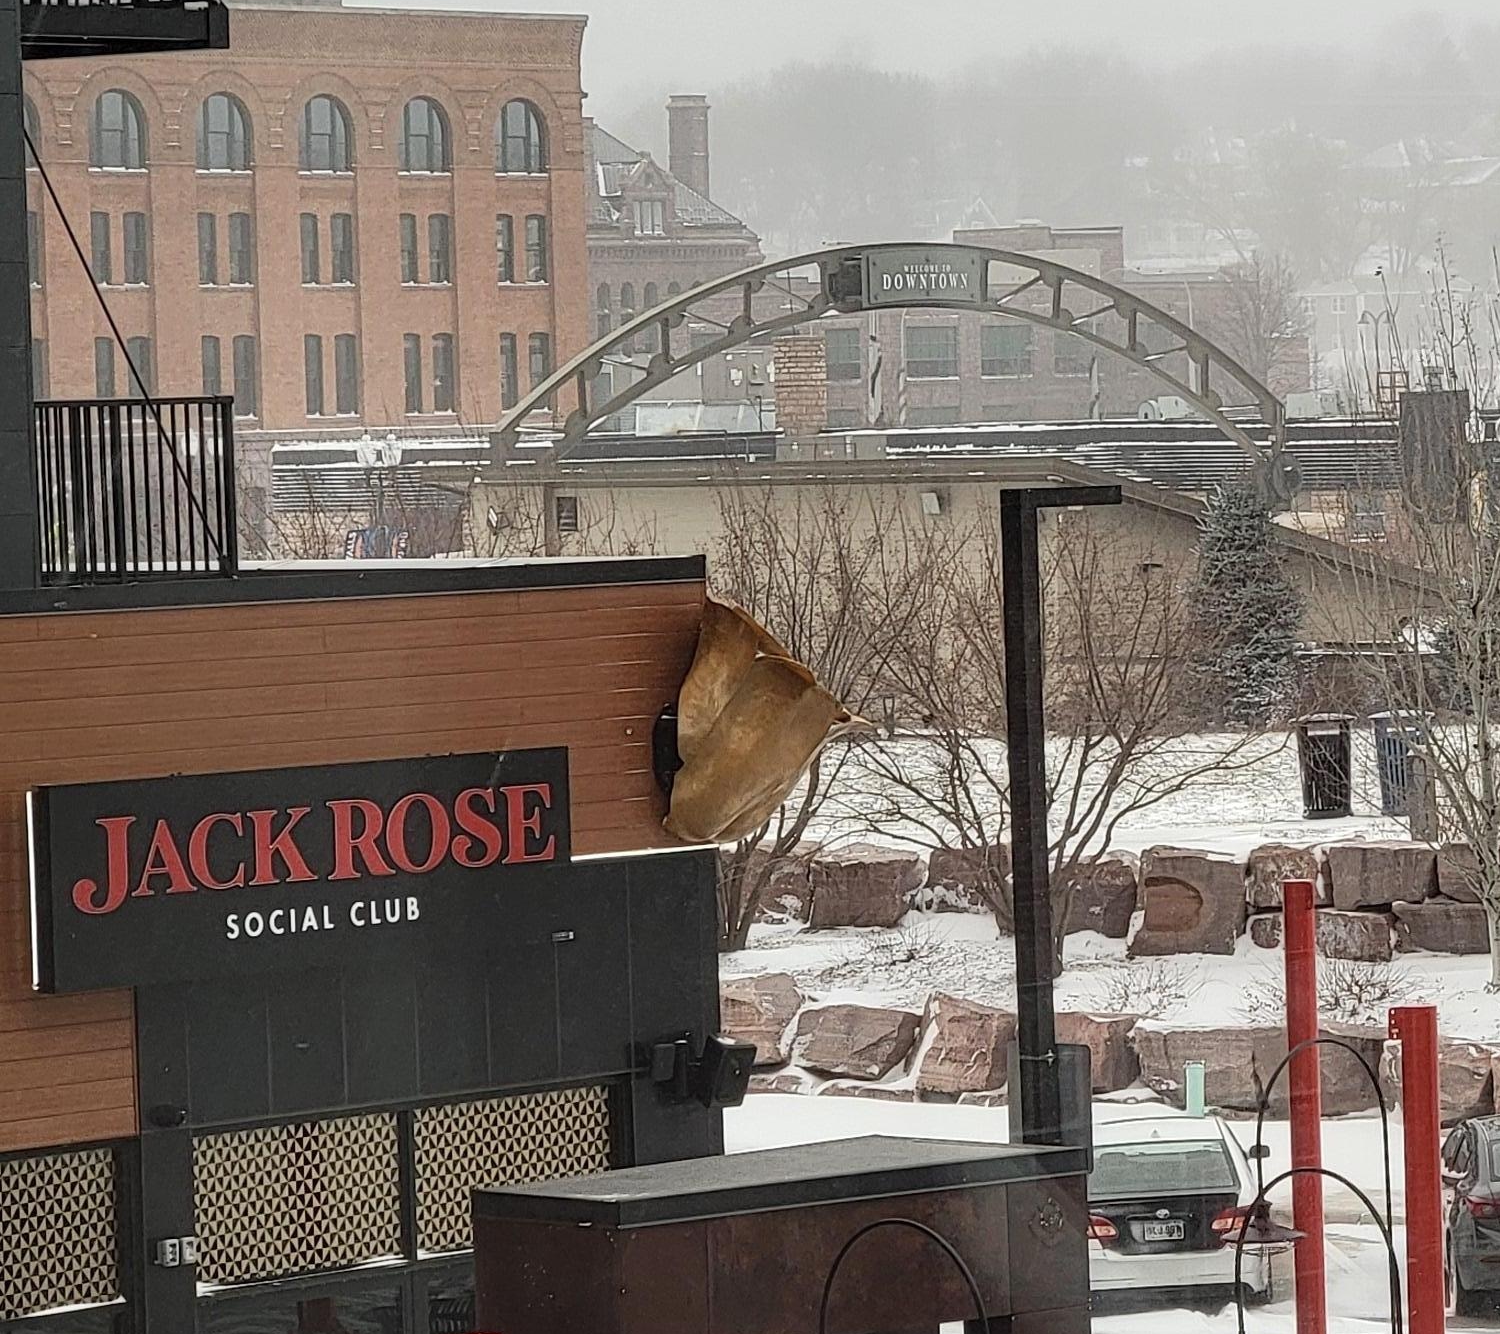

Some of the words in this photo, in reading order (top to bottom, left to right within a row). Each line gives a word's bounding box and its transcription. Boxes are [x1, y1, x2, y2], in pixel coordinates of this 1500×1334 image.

[882, 273, 968, 290] DOWNTOWN
[72, 805, 318, 915] JACK
[326, 782, 556, 880] ROSE
[226, 903, 334, 940] SOCIAL
[350, 896, 421, 928] CLUB
